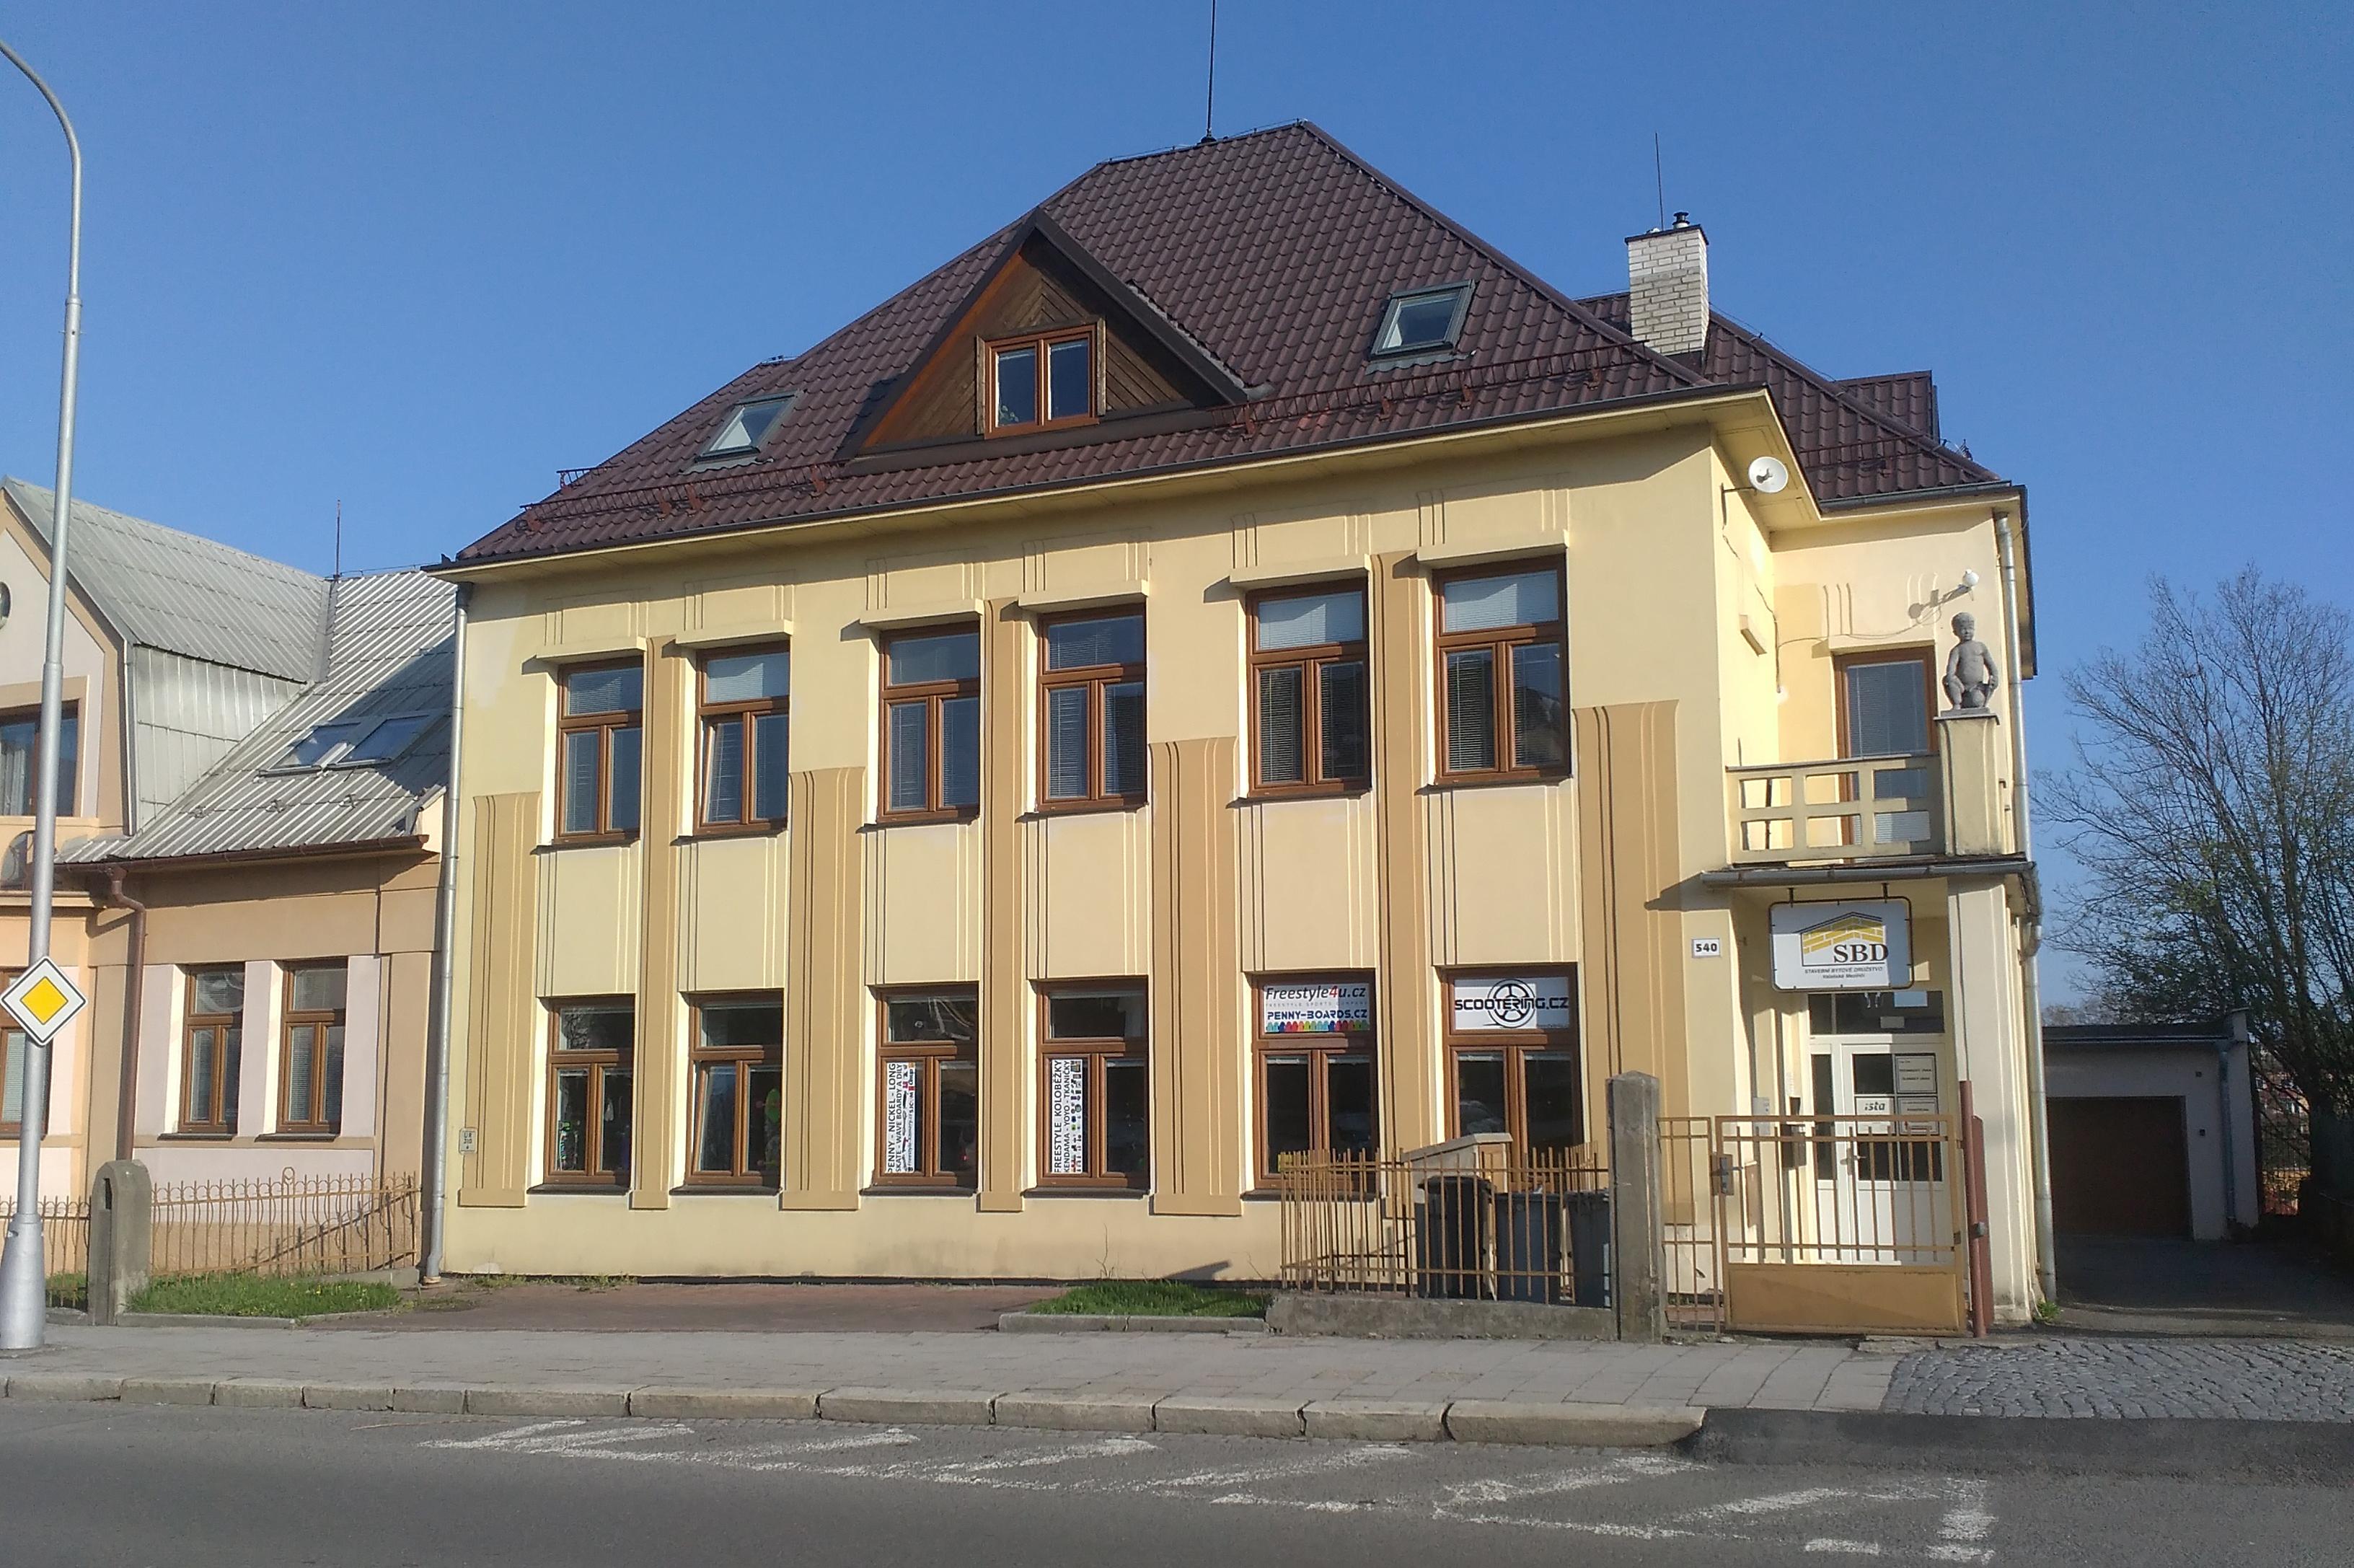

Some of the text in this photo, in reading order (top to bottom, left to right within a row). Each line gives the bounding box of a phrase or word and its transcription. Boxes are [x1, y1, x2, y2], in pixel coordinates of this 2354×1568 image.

[1696, 943, 1717, 953] 540
[1834, 943, 1889, 962] SBD
[1266, 985, 1366, 1002] Freestyle4u.cz
[1455, 997, 1569, 1010] SCOOTERING.CZ
[1267, 1009, 1367, 1020] PENNY-BOARDS.CZ
[1052, 1060, 1062, 1116] KOLOBĚŽKY
[1864, 1101, 1885, 1111] ista
